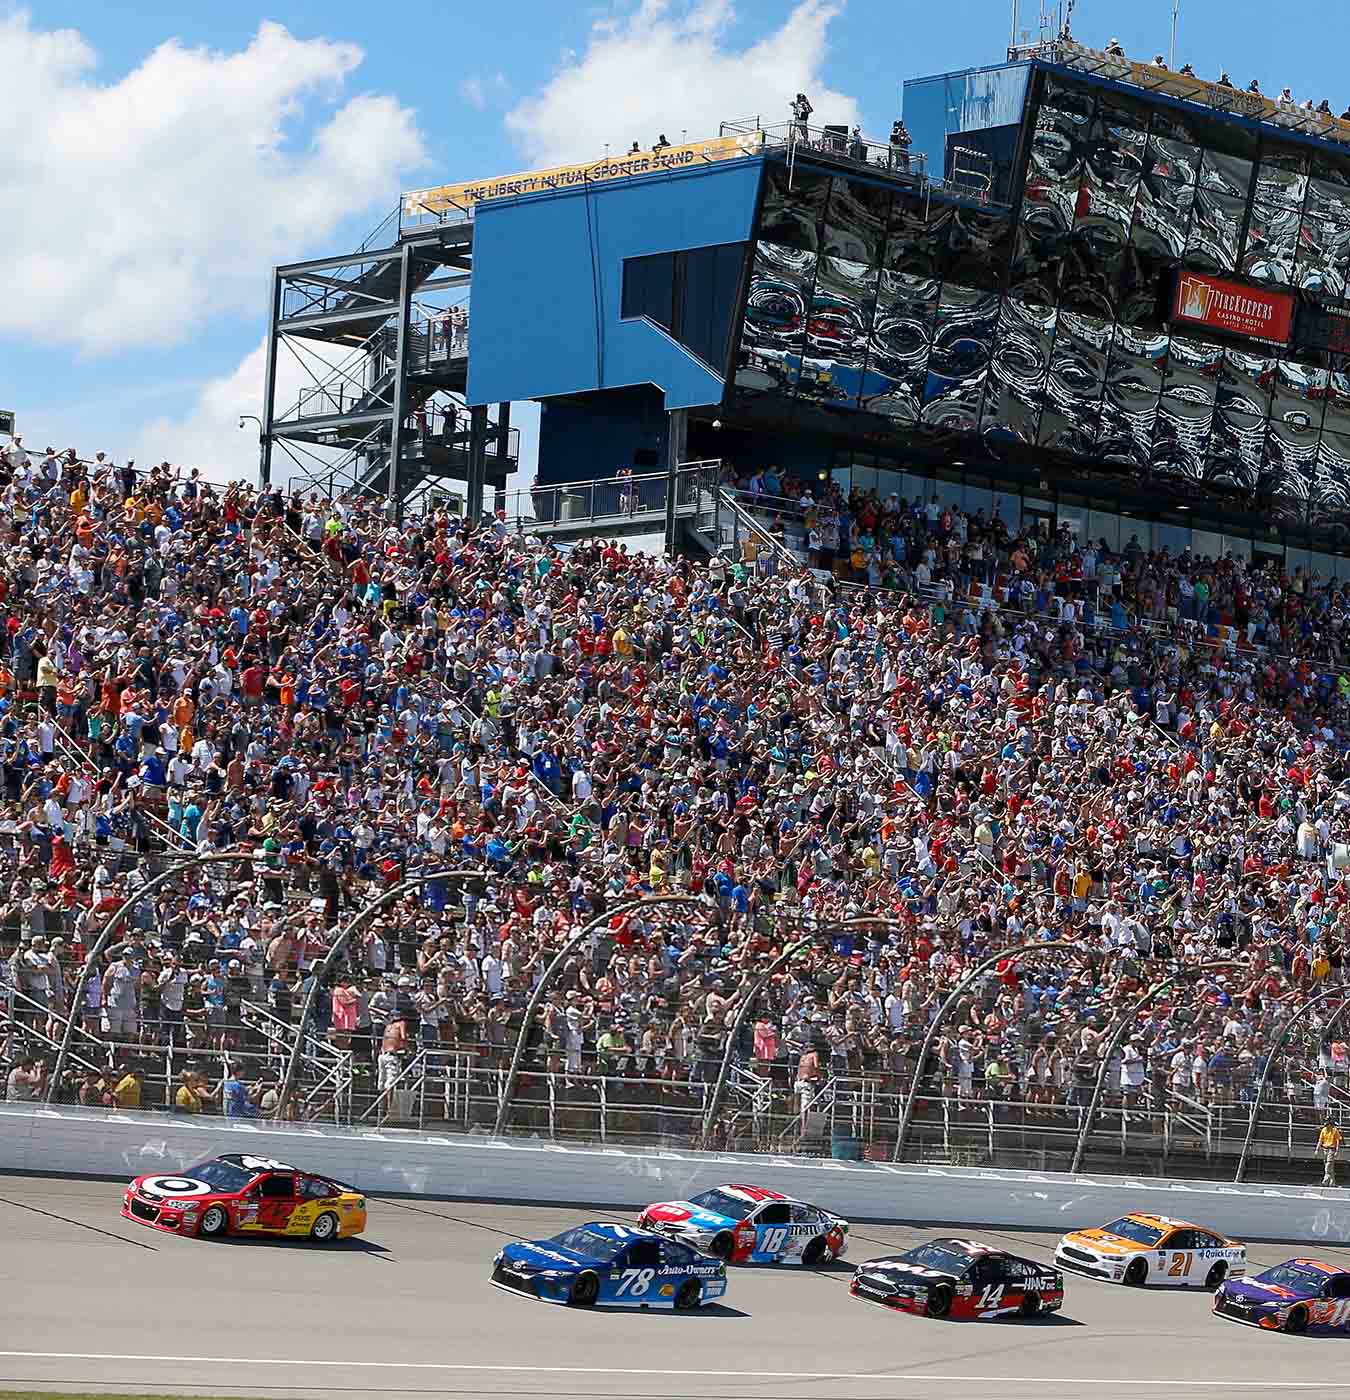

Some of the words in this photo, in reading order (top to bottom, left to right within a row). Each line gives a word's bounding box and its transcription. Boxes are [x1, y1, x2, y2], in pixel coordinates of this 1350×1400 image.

[463, 187, 486, 200] THE
[488, 177, 538, 198] LIBERTY
[541, 171, 590, 188] MUTUAL
[593, 158, 650, 179] SPOTTER
[652, 150, 694, 167] STAND
[758, 1227, 788, 1254] 18
[657, 1264, 717, 1276] Auto-Owners
[1167, 1252, 1193, 1277] 21
[615, 1267, 656, 1297] 78
[1023, 1277, 1047, 1291] HAAS
[974, 1284, 1005, 1309] 14
